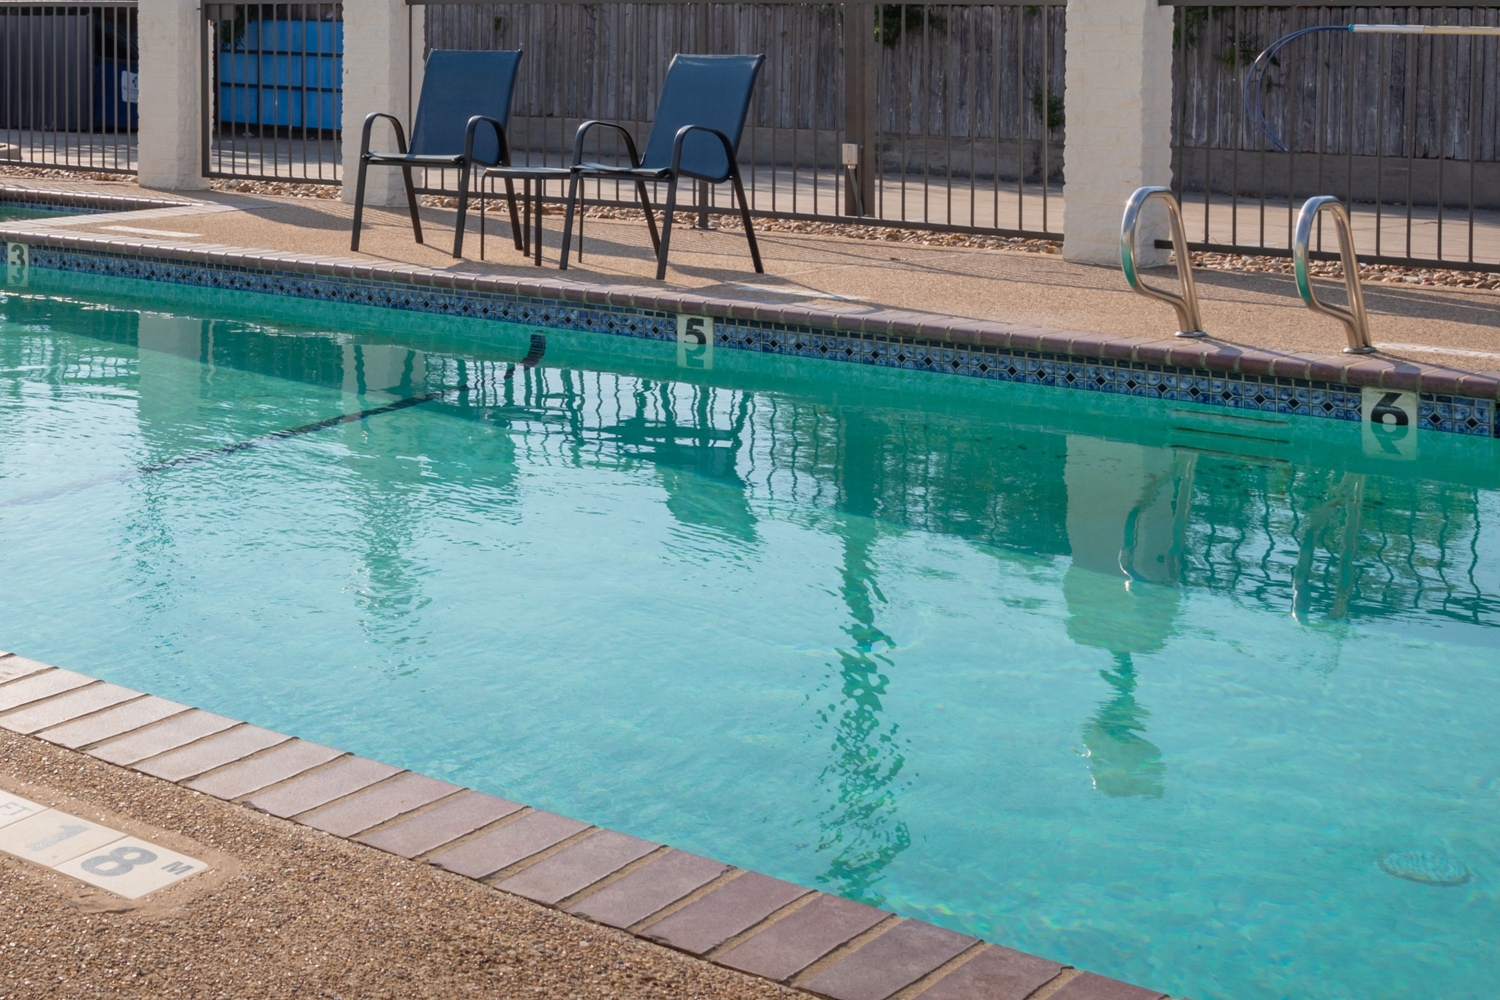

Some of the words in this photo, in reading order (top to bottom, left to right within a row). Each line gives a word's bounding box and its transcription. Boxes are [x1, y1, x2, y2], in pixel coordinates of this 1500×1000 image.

[11, 244, 26, 265] 3
[684, 317, 707, 345] 5
[1370, 391, 1409, 427] 6
[160, 860, 195, 876] M
